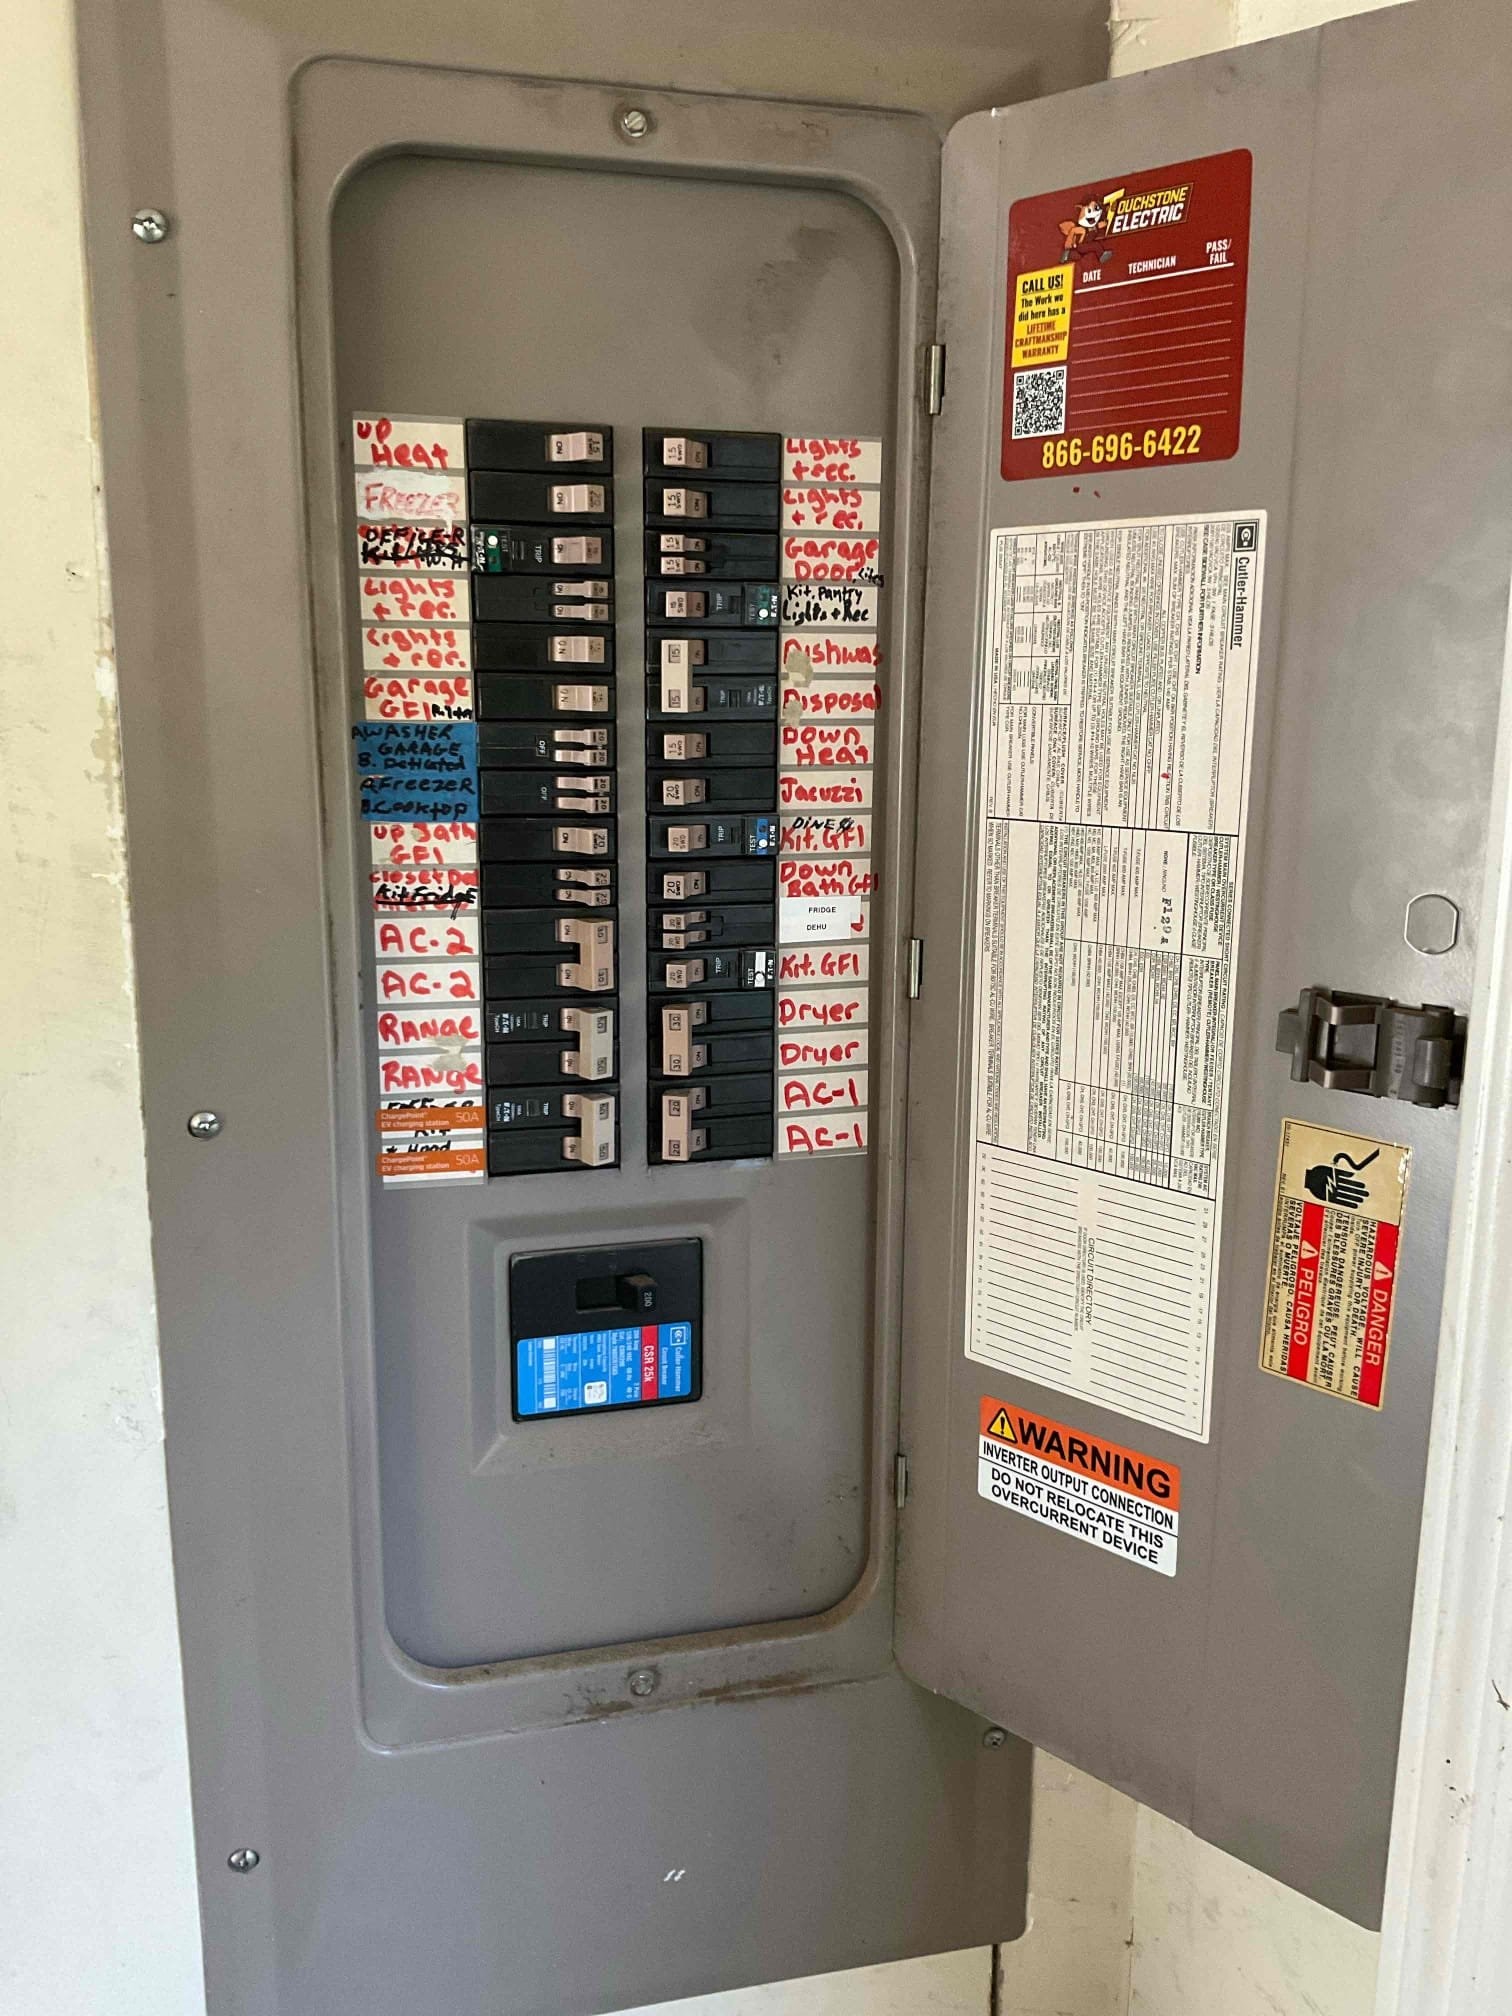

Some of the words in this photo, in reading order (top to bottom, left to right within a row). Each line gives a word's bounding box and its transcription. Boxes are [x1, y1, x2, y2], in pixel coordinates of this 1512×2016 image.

[1103, 186, 1189, 224] TOUCHSTONE
[1112, 203, 1185, 234] ELECTRIC
[1206, 238, 1232, 254] PASS/
[1083, 269, 1101, 283] DATE
[1128, 256, 1177, 275] TECHNICIAN
[1209, 252, 1227, 265] FAIL
[1022, 278, 1044, 294] CALL
[1048, 274, 1064, 288] US!
[1021, 298, 1033, 309] The
[1035, 295, 1052, 306] Work
[1054, 294, 1063, 302] we
[1018, 311, 1029, 321] did
[1031, 309, 1045, 319] here
[1048, 306, 1059, 316] has
[1061, 307, 1066, 315] a
[1027, 321, 1056, 334] LIFETIME
[1015, 331, 1067, 348] CRAFTMANSHIP
[1022, 345, 1059, 359] WARRANTY
[556, 441, 563, 454] ON
[668, 448, 677, 459] 15
[1042, 424, 1201, 469] 866-696-6422
[556, 492, 564, 505] ON
[667, 495, 676, 507] 15
[534, 545, 542, 563] TRIP
[785, 537, 879, 568] Garage
[1234, 557, 1250, 648] Cutler-Hammer
[671, 648, 680, 659] 15
[671, 695, 681, 705] 15
[378, 741, 462, 756] GARAGE
[668, 742, 676, 754] 15
[667, 786, 674, 798] 20
[780, 777, 863, 803] Jacuzzi
[562, 832, 569, 844] ON
[598, 834, 605, 848] 20
[667, 881, 675, 894] 20
[808, 906, 837, 914] FRIDGE
[1225, 904, 1233, 941] CONNECTED
[821, 952, 860, 977] GFI
[672, 1016, 681, 1027] 30
[779, 998, 860, 1026] Dryer
[672, 1058, 681, 1070] 30
[780, 1041, 860, 1066] Dryer
[784, 1078, 859, 1110] AC-1
[455, 1112, 479, 1123] 50A
[671, 1101, 680, 1113] 20
[393, 1121, 424, 1129] charging
[672, 1143, 680, 1155] 20
[786, 1123, 863, 1155] AC-1
[394, 1164, 424, 1172] charging
[455, 1154, 480, 1166] 50A
[1286, 1200, 1295, 1240] SEVERAS
[1293, 1201, 1303, 1240] VOLTAJE
[1339, 1214, 1349, 1255] TENSION
[1359, 1220, 1368, 1254] SEVERE
[1087, 1238, 1095, 1274] CIRCUIT
[1329, 1233, 1340, 1286] BLESSURES
[1364, 1221, 1376, 1279] HAZARDOUS
[1356, 1257, 1365, 1292] INJURY
[1085, 1274, 1094, 1325] DIRECTORY
[1294, 1267, 1314, 1345] PELIGRO
[1325, 1288, 1335, 1323] GRAVES
[1354, 1294, 1362, 1305] OR
[1284, 1301, 1293, 1330] CAUSA
[1324, 1325, 1332, 1338] OU
[1330, 1325, 1338, 1347] PEUT
[1365, 1289, 1388, 1366] DANGER
[644, 1344, 654, 1363] CSR
[1279, 1334, 1290, 1372] HERIDAS
[1323, 1341, 1330, 1352] LA
[1355, 1337, 1363, 1359] WILL
[644, 1366, 654, 1383] 25k
[1325, 1352, 1335, 1388] CAUSER
[1351, 1366, 1361, 1397] CAUSE
[1018, 1416, 1172, 1499] WARNING
[983, 1441, 1038, 1477] INVERTER
[1041, 1465, 1089, 1496] OUTPUT
[1091, 1485, 1174, 1530] CONNECTION
[991, 1467, 1011, 1486] DO
[1016, 1476, 1044, 1496] NOT
[1047, 1489, 1126, 1534] RELOCATE
[1129, 1523, 1164, 1549] THIS
[991, 1484, 1099, 1538] OVERCURRENT
[1102, 1531, 1159, 1565] DEVICE
